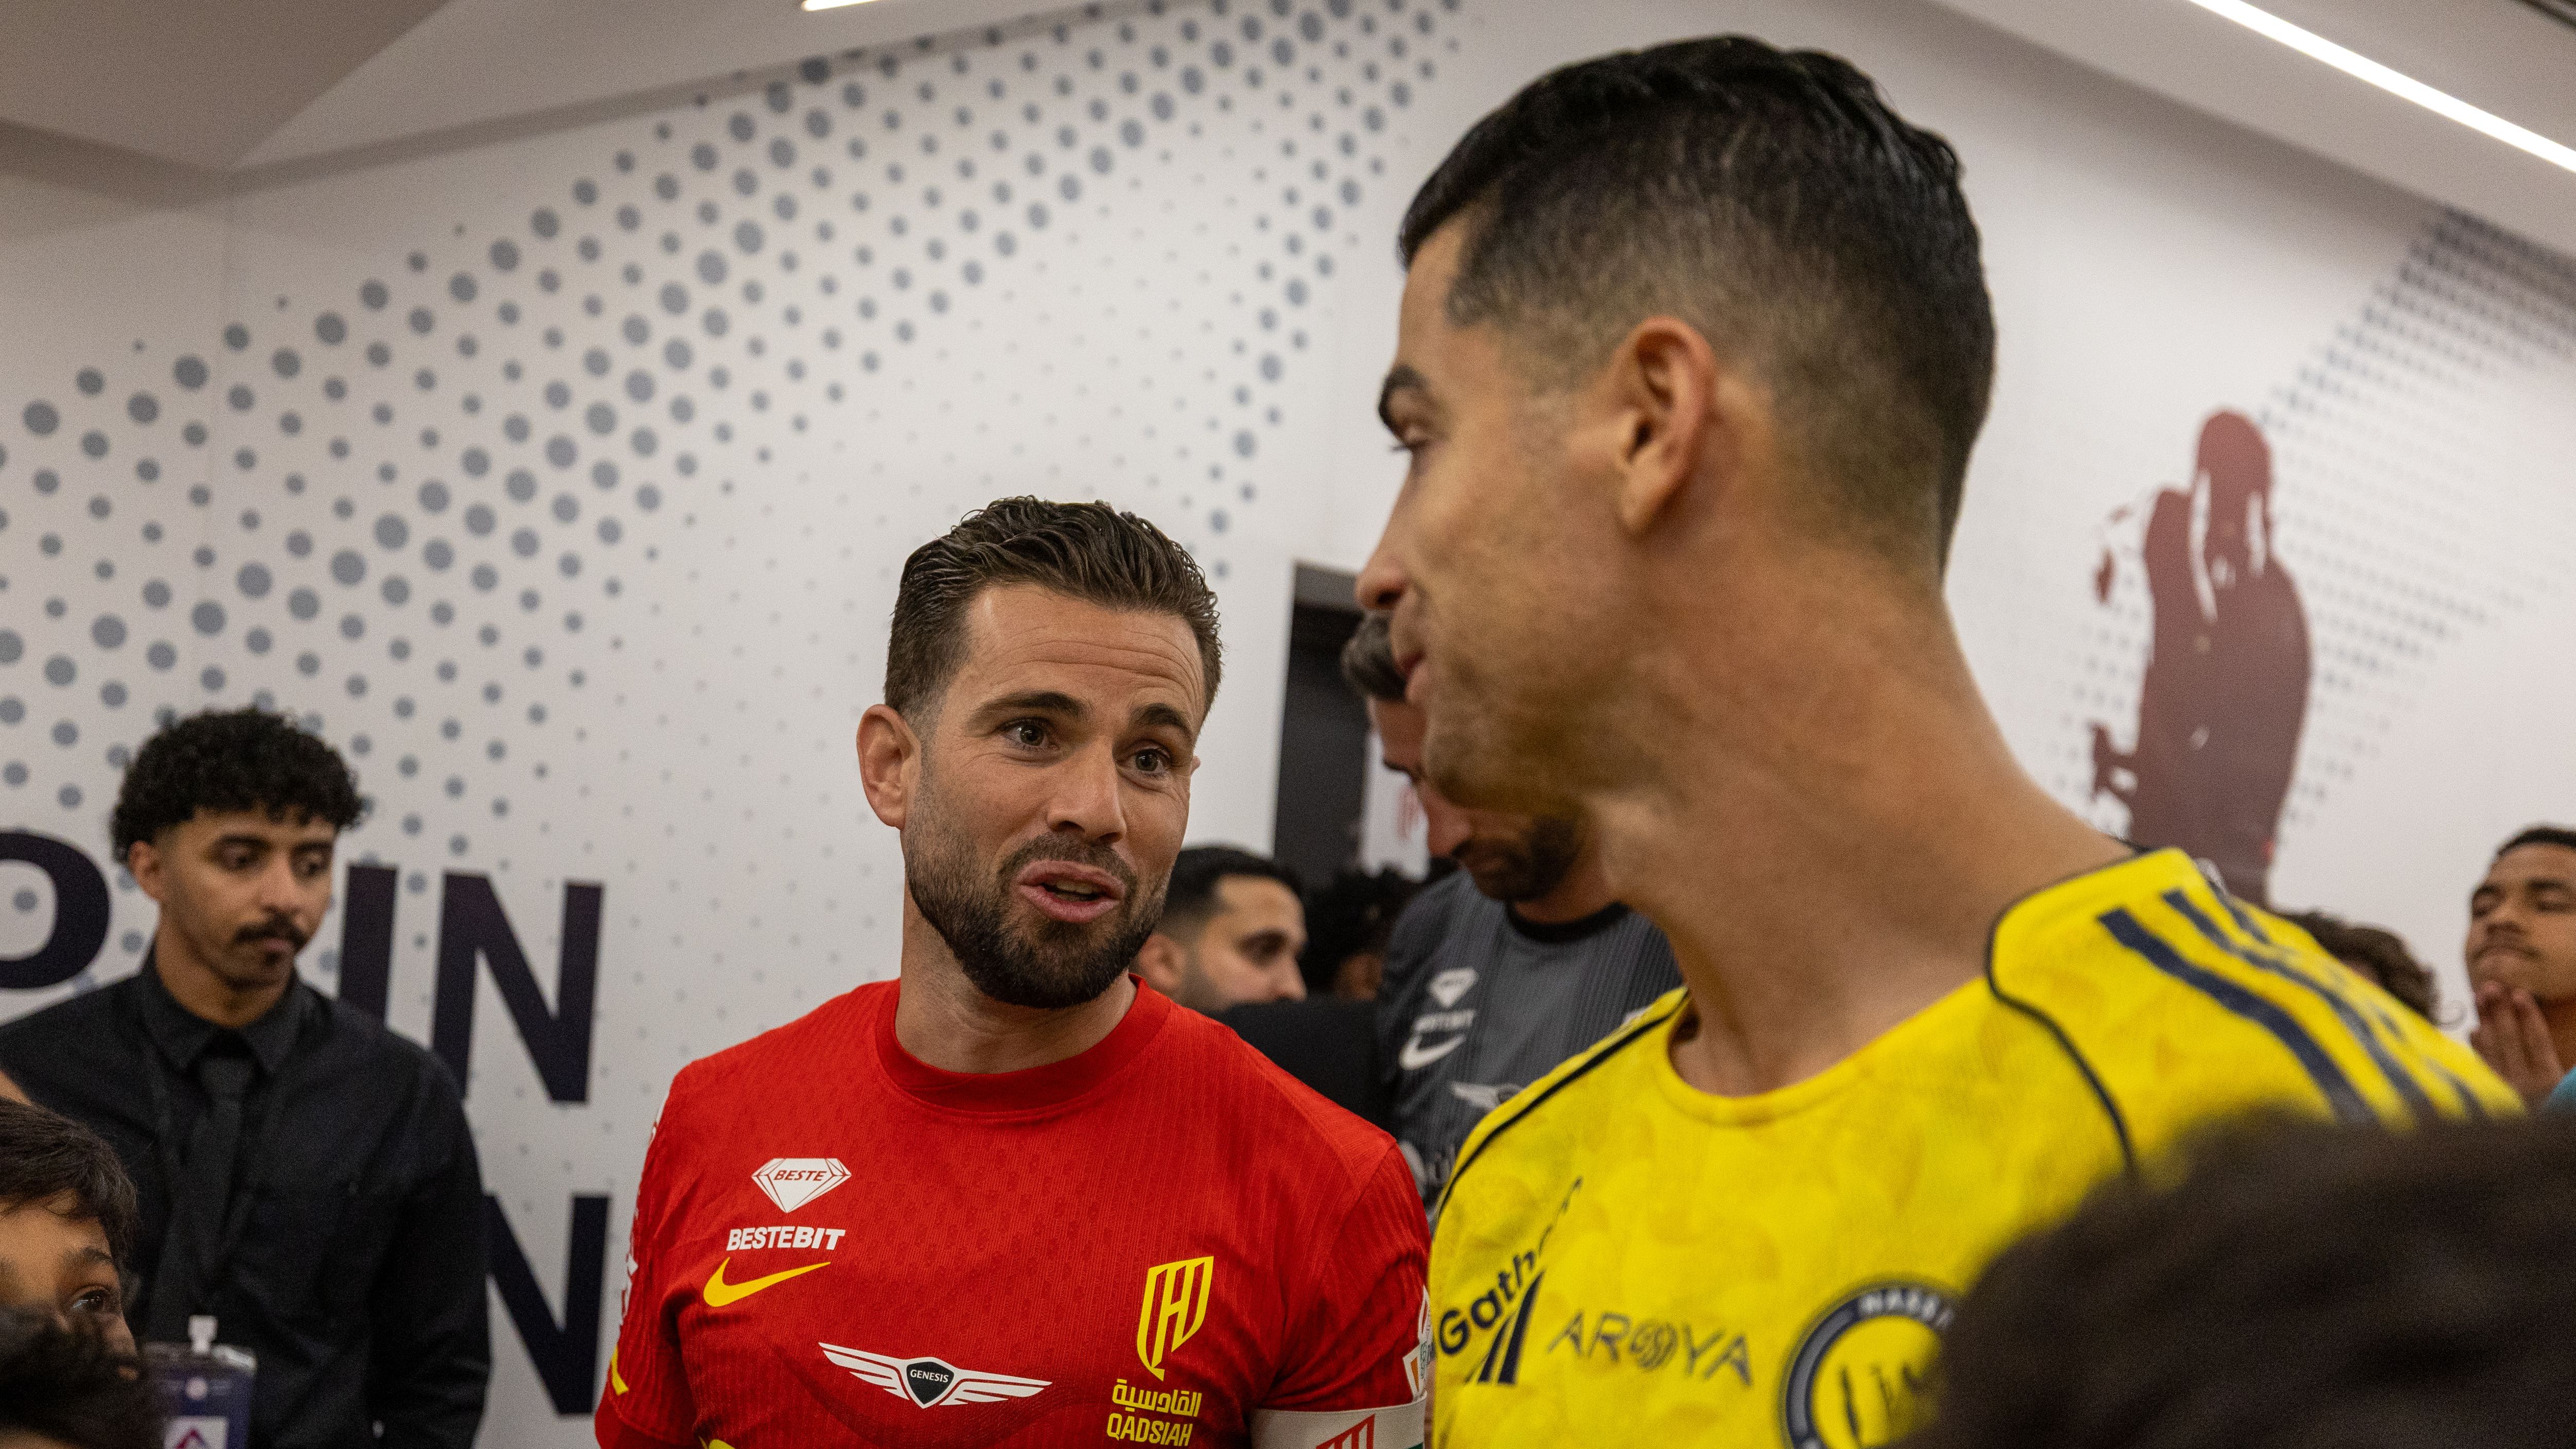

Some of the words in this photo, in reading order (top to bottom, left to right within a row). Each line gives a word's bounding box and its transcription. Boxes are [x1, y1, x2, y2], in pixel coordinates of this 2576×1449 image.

[774, 1169, 827, 1181] BESTE
[726, 1226, 846, 1251] BESTEBIT
[910, 1369, 949, 1383] GENESIS
[1112, 1378, 1202, 1417] القادسية
[1107, 1413, 1193, 1447] QADSIAH
